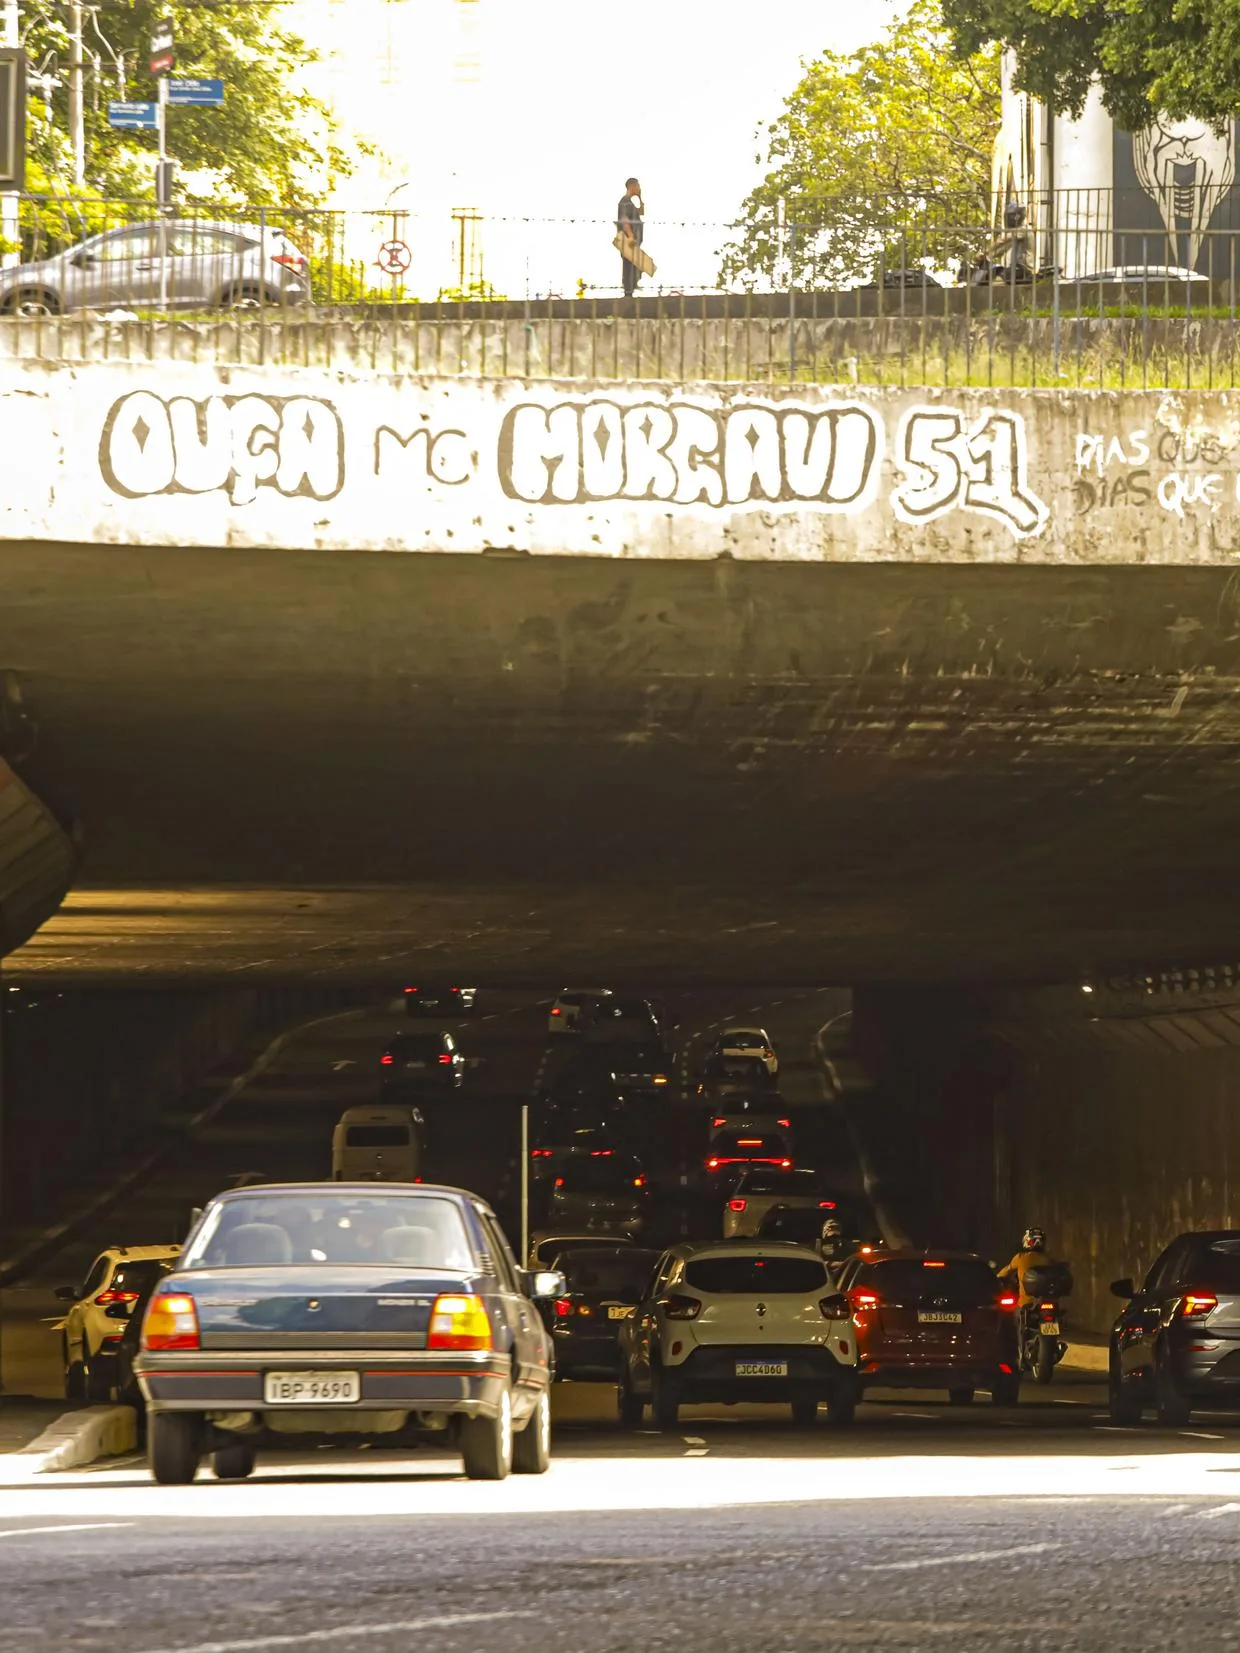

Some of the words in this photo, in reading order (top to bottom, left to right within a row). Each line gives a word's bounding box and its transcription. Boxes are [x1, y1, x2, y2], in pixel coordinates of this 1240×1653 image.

[892, 404, 1047, 538] 51
[1075, 430, 1150, 478] DIAS
[1157, 431, 1226, 466] QUE
[1074, 470, 1150, 515] DIAS
[1157, 472, 1224, 518] QUE
